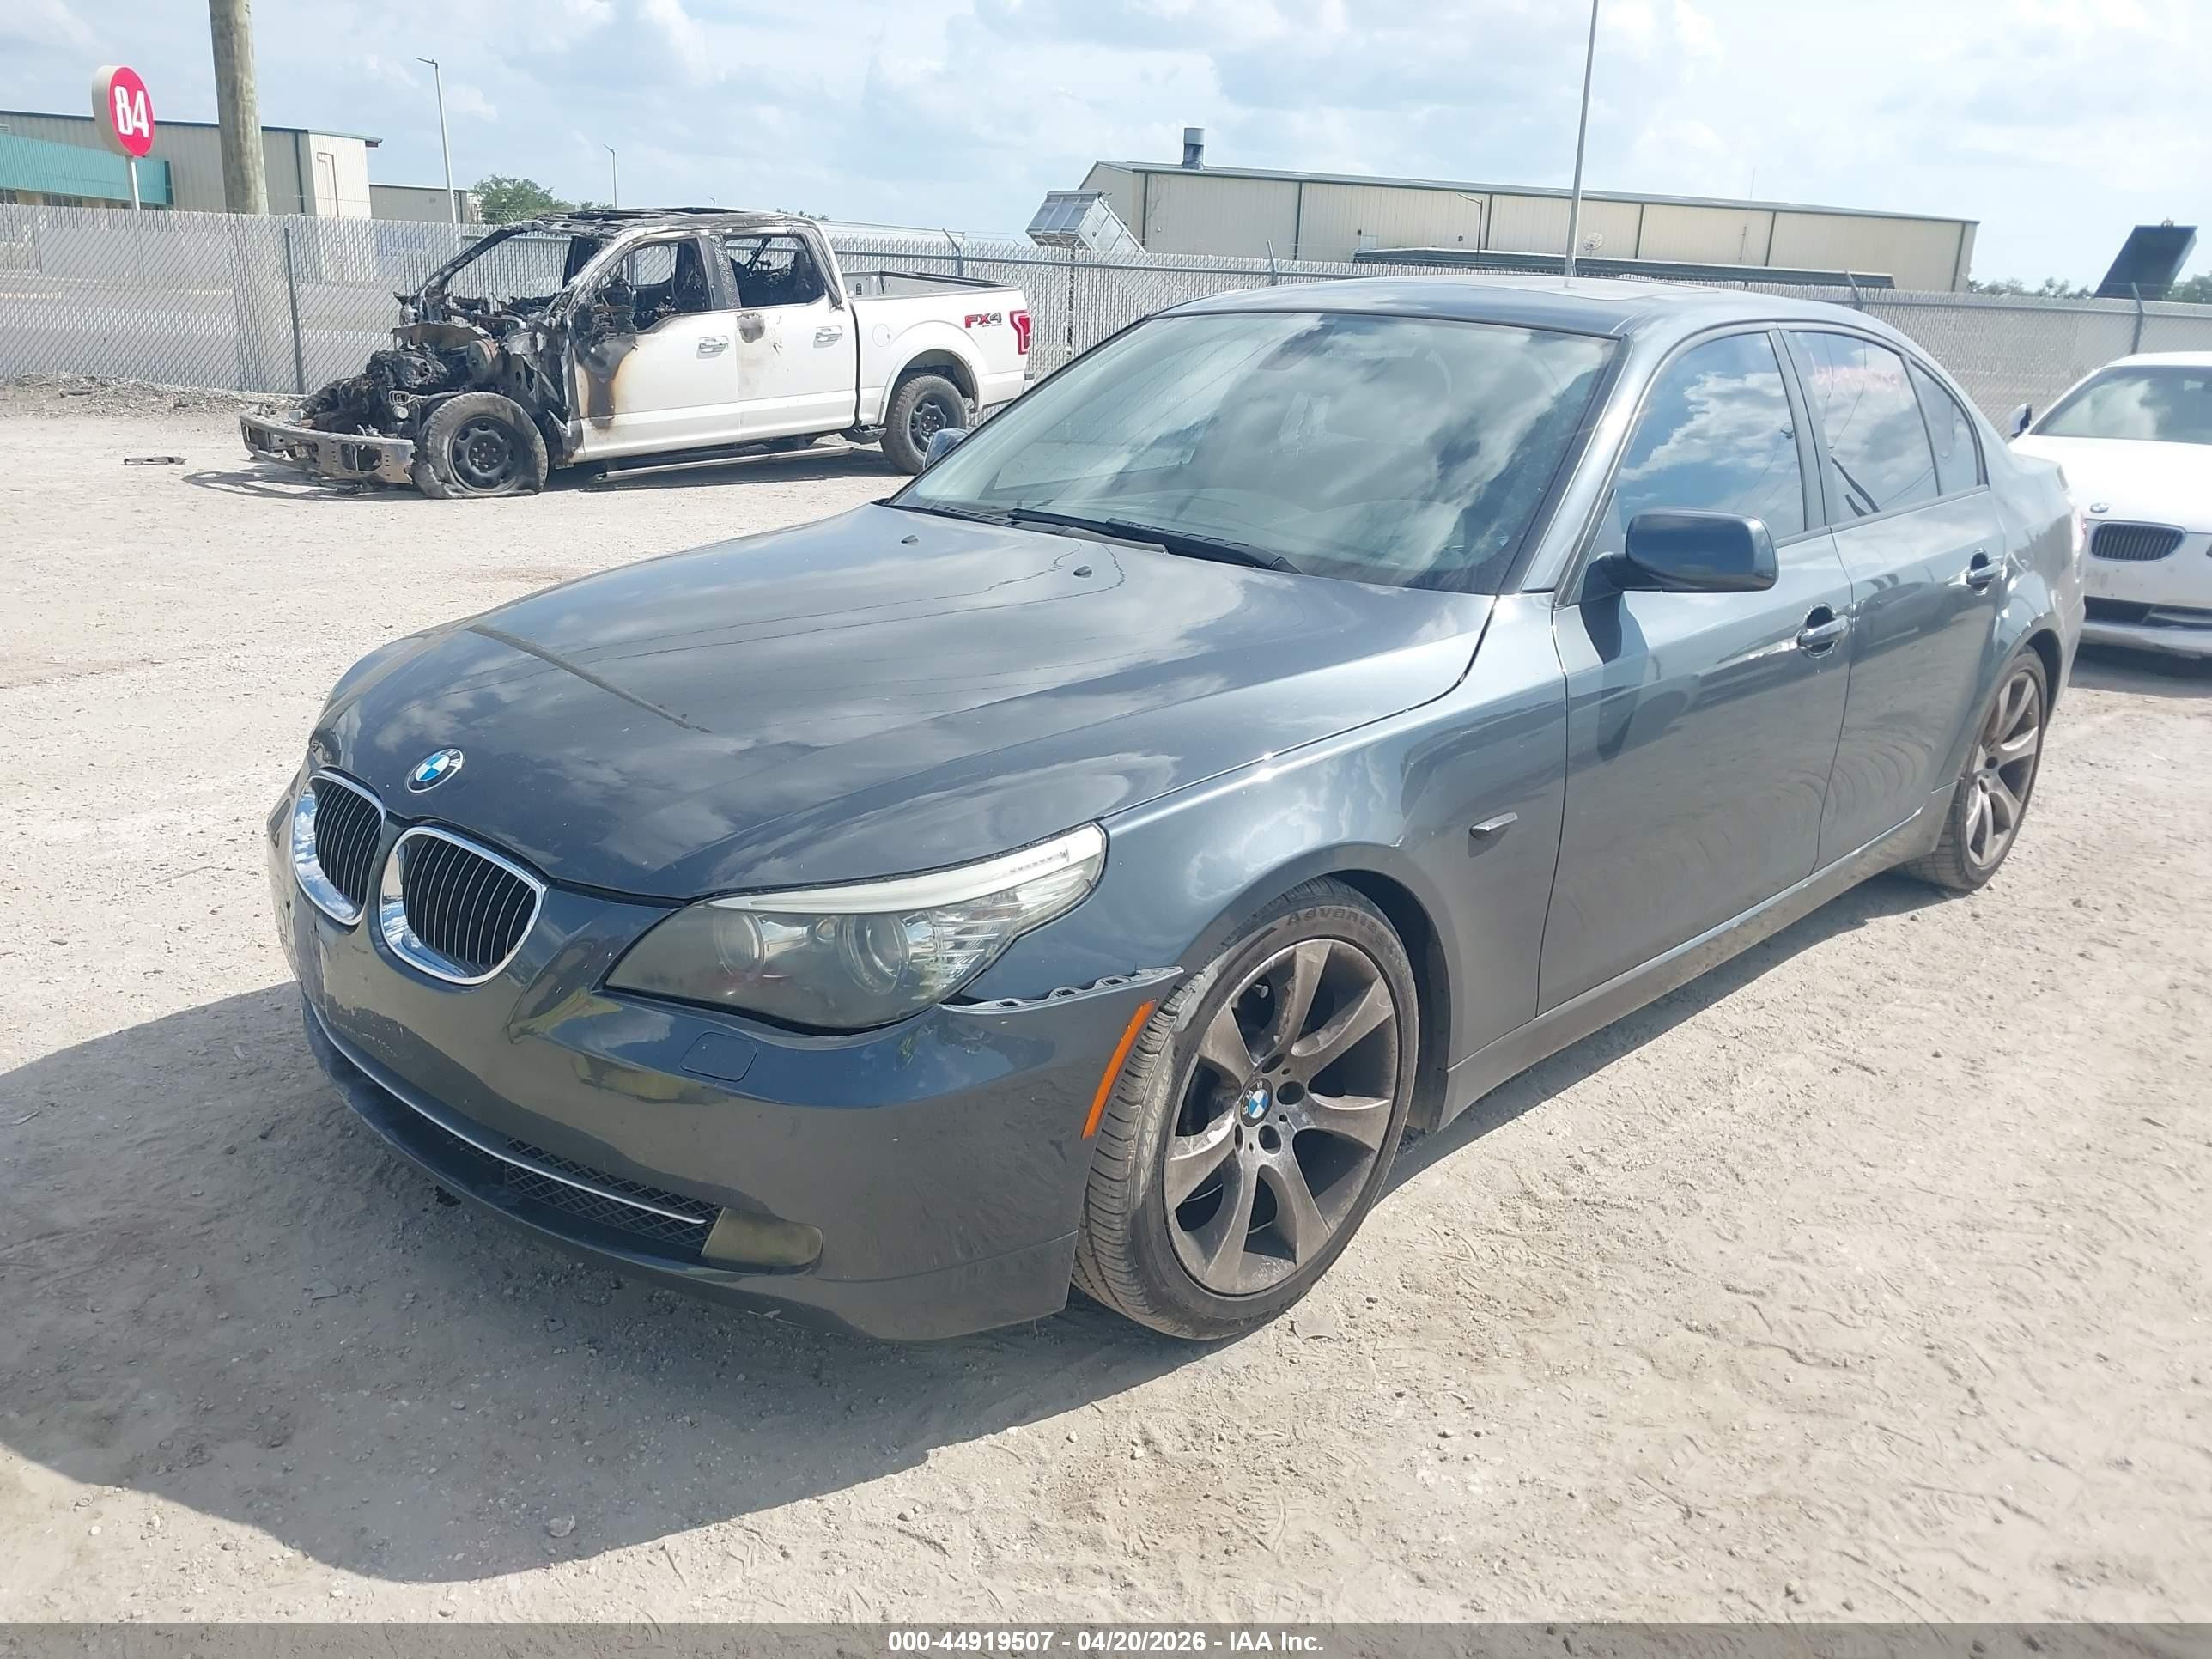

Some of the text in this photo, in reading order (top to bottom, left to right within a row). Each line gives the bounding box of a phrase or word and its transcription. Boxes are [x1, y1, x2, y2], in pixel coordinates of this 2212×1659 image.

[114, 85, 149, 138] 84
[964, 312, 1002, 328] FX4
[1242, 1079, 1263, 1115] BMW
